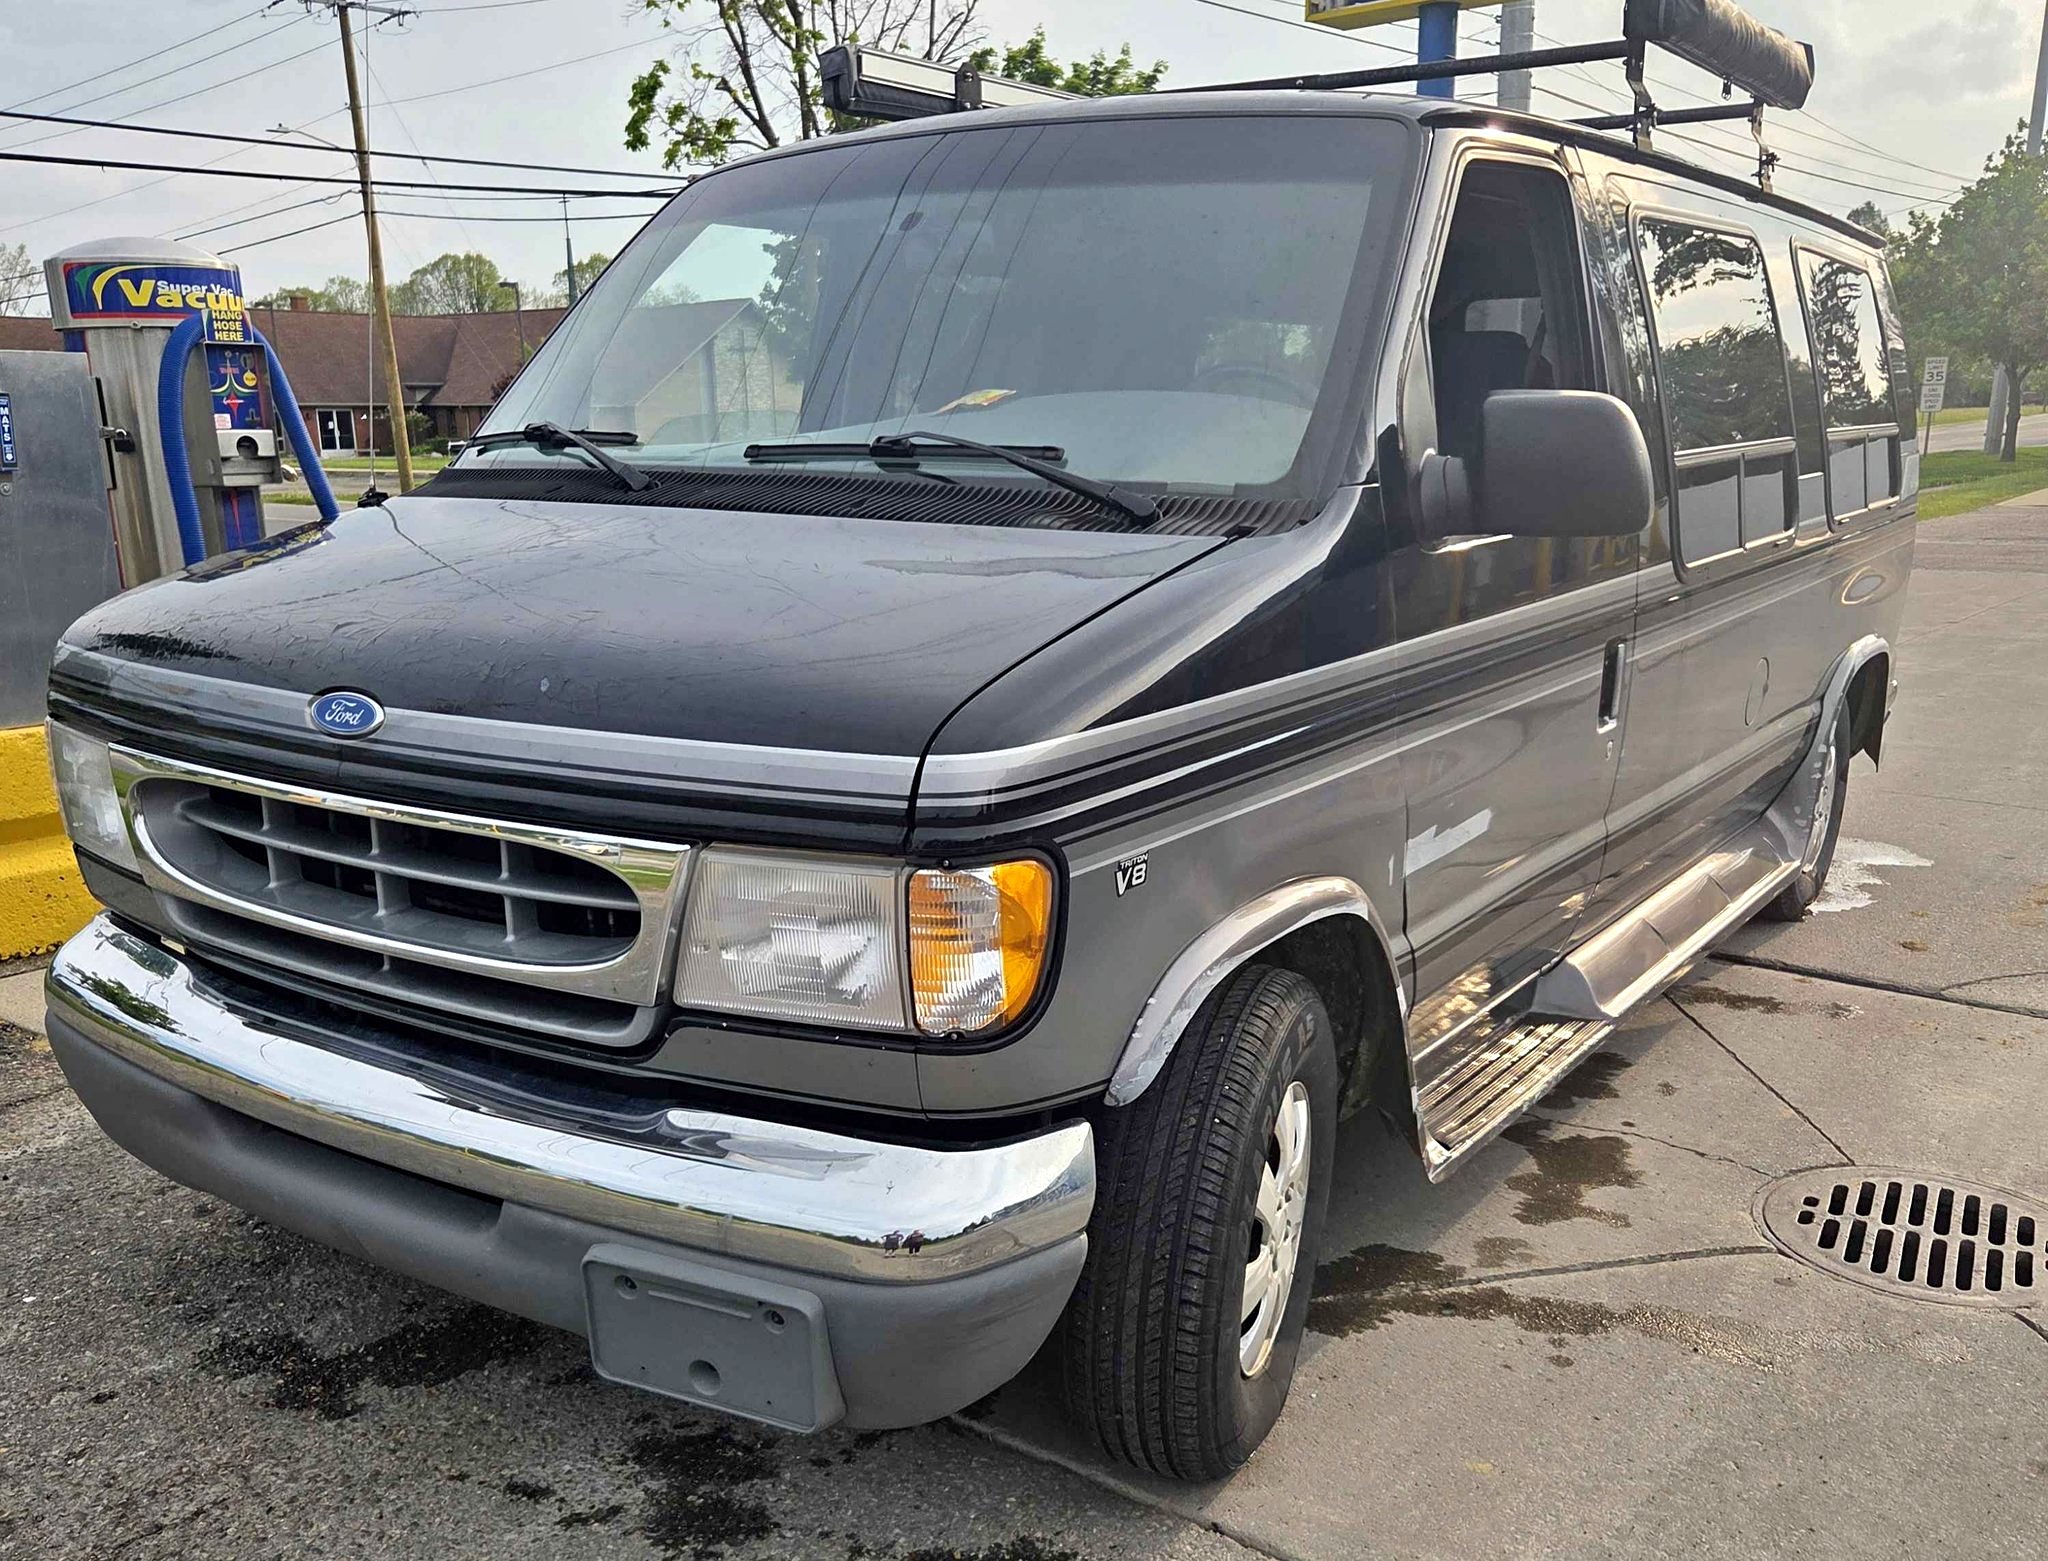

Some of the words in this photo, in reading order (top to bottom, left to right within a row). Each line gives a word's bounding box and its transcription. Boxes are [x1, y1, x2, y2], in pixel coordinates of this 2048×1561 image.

[157, 280, 208, 295] Super
[210, 283, 234, 295] Vac
[212, 310, 243, 320] HANG
[213, 321, 244, 331] HOSE
[215, 331, 244, 342] HERE
[1926, 371, 1944, 382] 35
[0, 406, 11, 442] MATS
[324, 699, 365, 726] Ford
[1120, 853, 1149, 869] TRITON
[1116, 862, 1147, 896] V8
